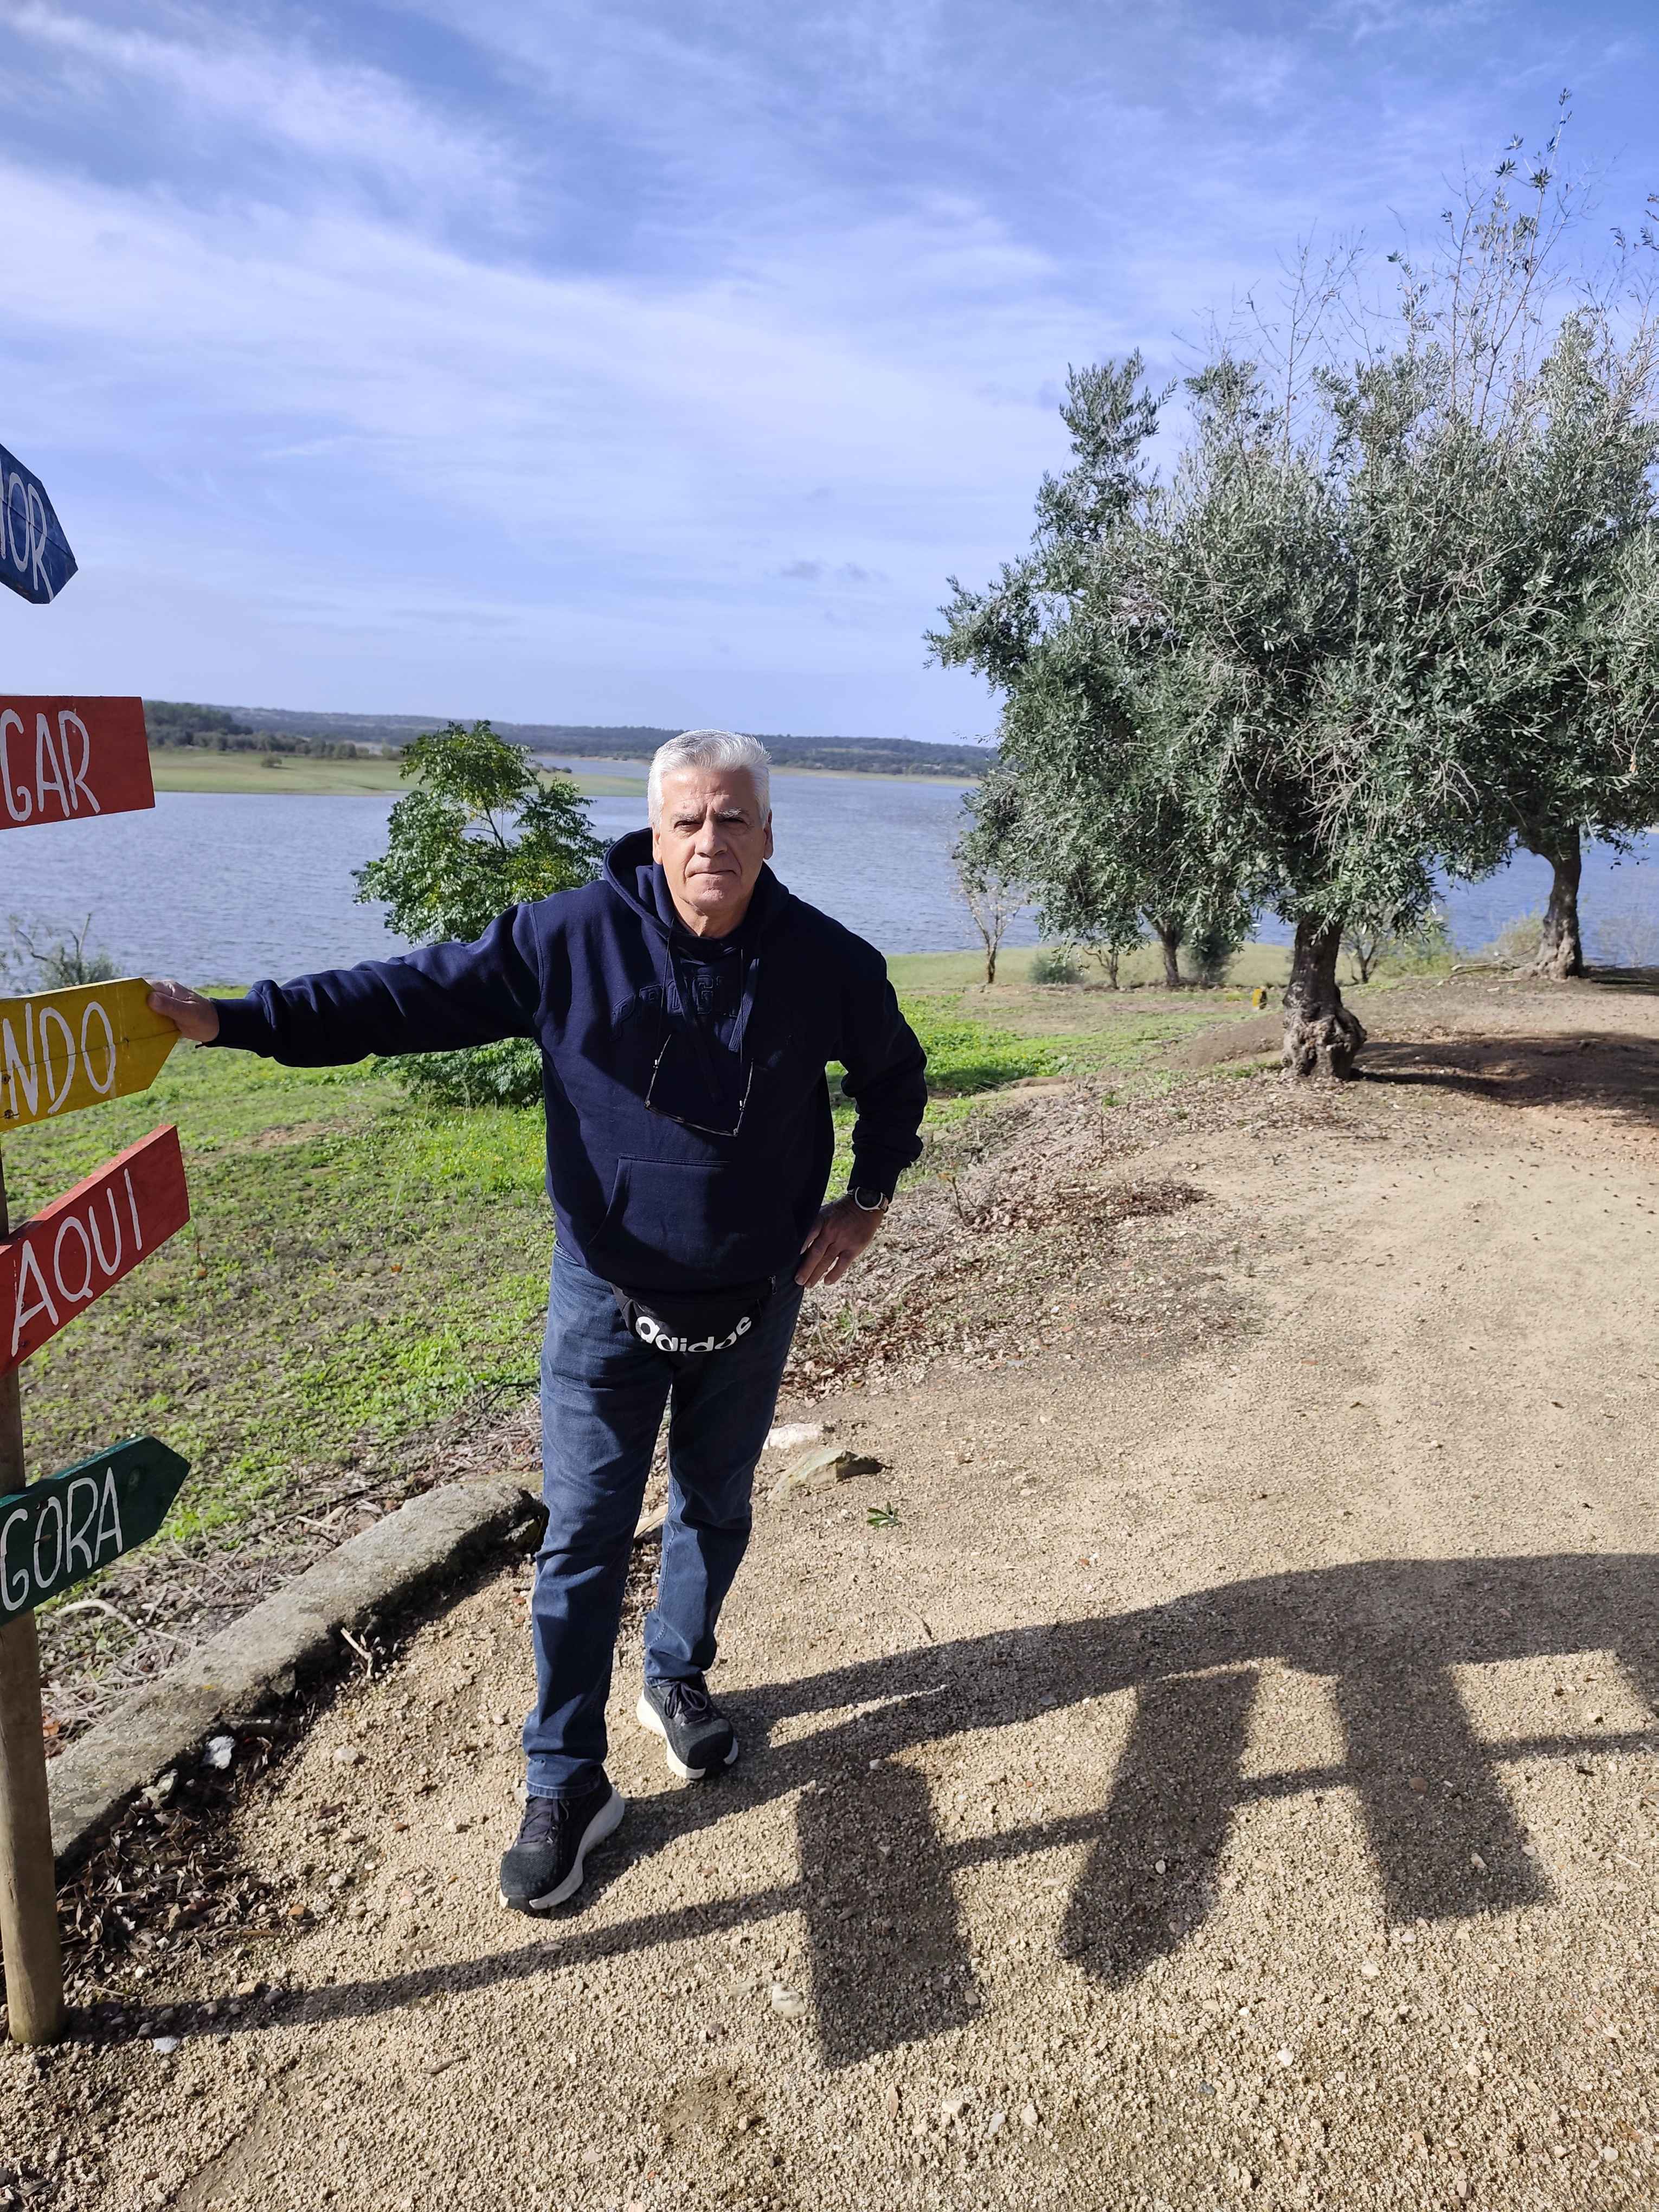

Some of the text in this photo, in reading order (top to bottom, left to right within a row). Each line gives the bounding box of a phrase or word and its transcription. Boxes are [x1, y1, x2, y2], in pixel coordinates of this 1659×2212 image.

[0, 460, 54, 601] OR
[0, 709, 100, 821] GAR
[0, 1001, 116, 1119] NDO
[11, 1168, 142, 1357] AQUI
[0, 1467, 123, 1611] GORA
